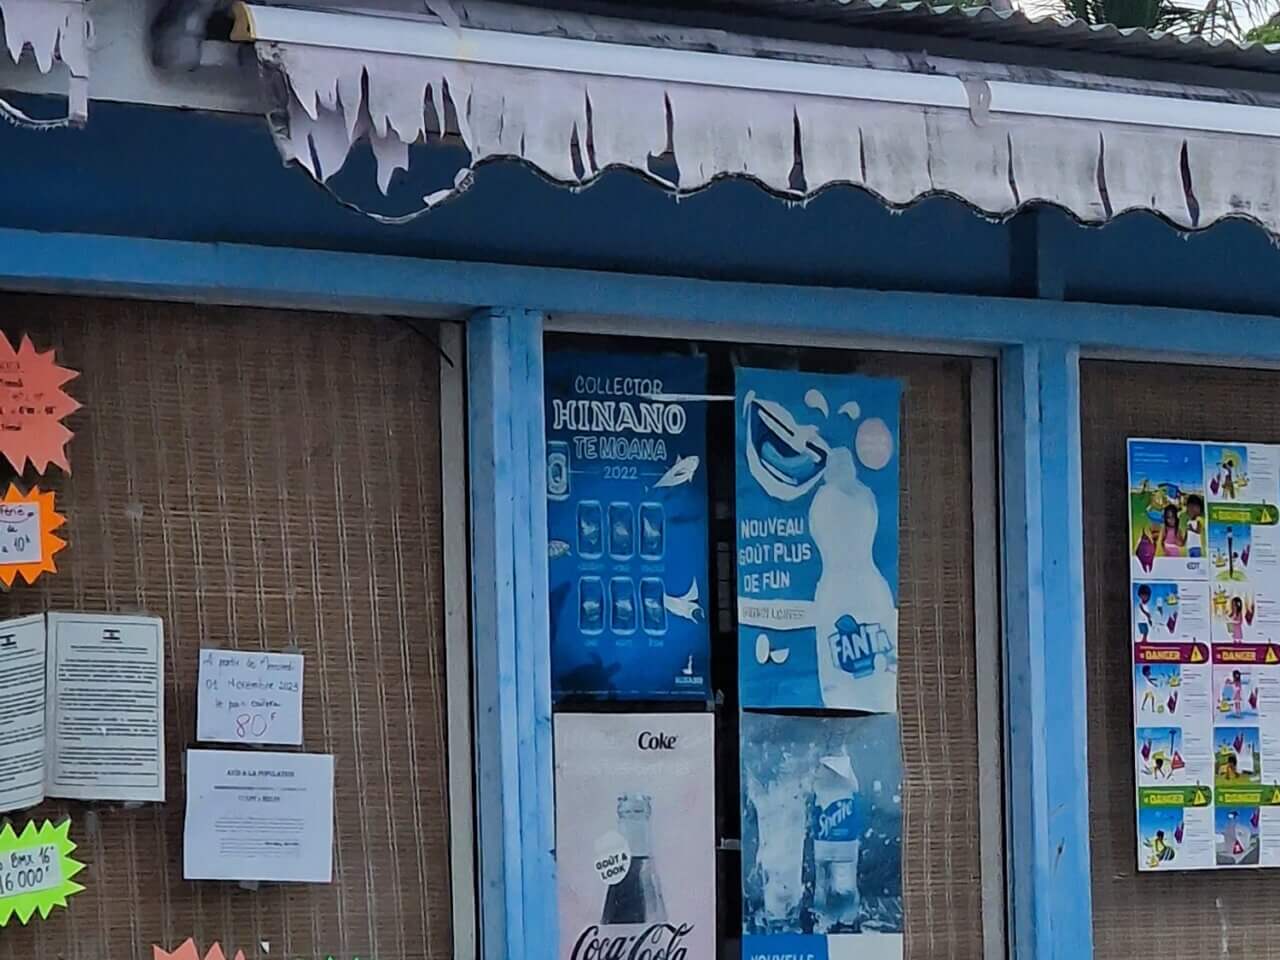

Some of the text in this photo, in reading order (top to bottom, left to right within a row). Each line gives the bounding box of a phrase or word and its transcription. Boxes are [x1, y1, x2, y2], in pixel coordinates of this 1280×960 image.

[574, 375, 663, 396] COLLECTOR
[552, 399, 687, 434] HINANO
[573, 436, 668, 461] TE MOANA
[603, 466, 639, 480] 2022
[741, 516, 804, 539] NOUVEAU
[774, 542, 811, 563] PLUS
[743, 569, 790, 593] DE FUN
[828, 623, 893, 665] FANTA
[638, 731, 677, 750] Coke
[818, 799, 853, 836] Sprite
[601, 865, 626, 879] LOOK
